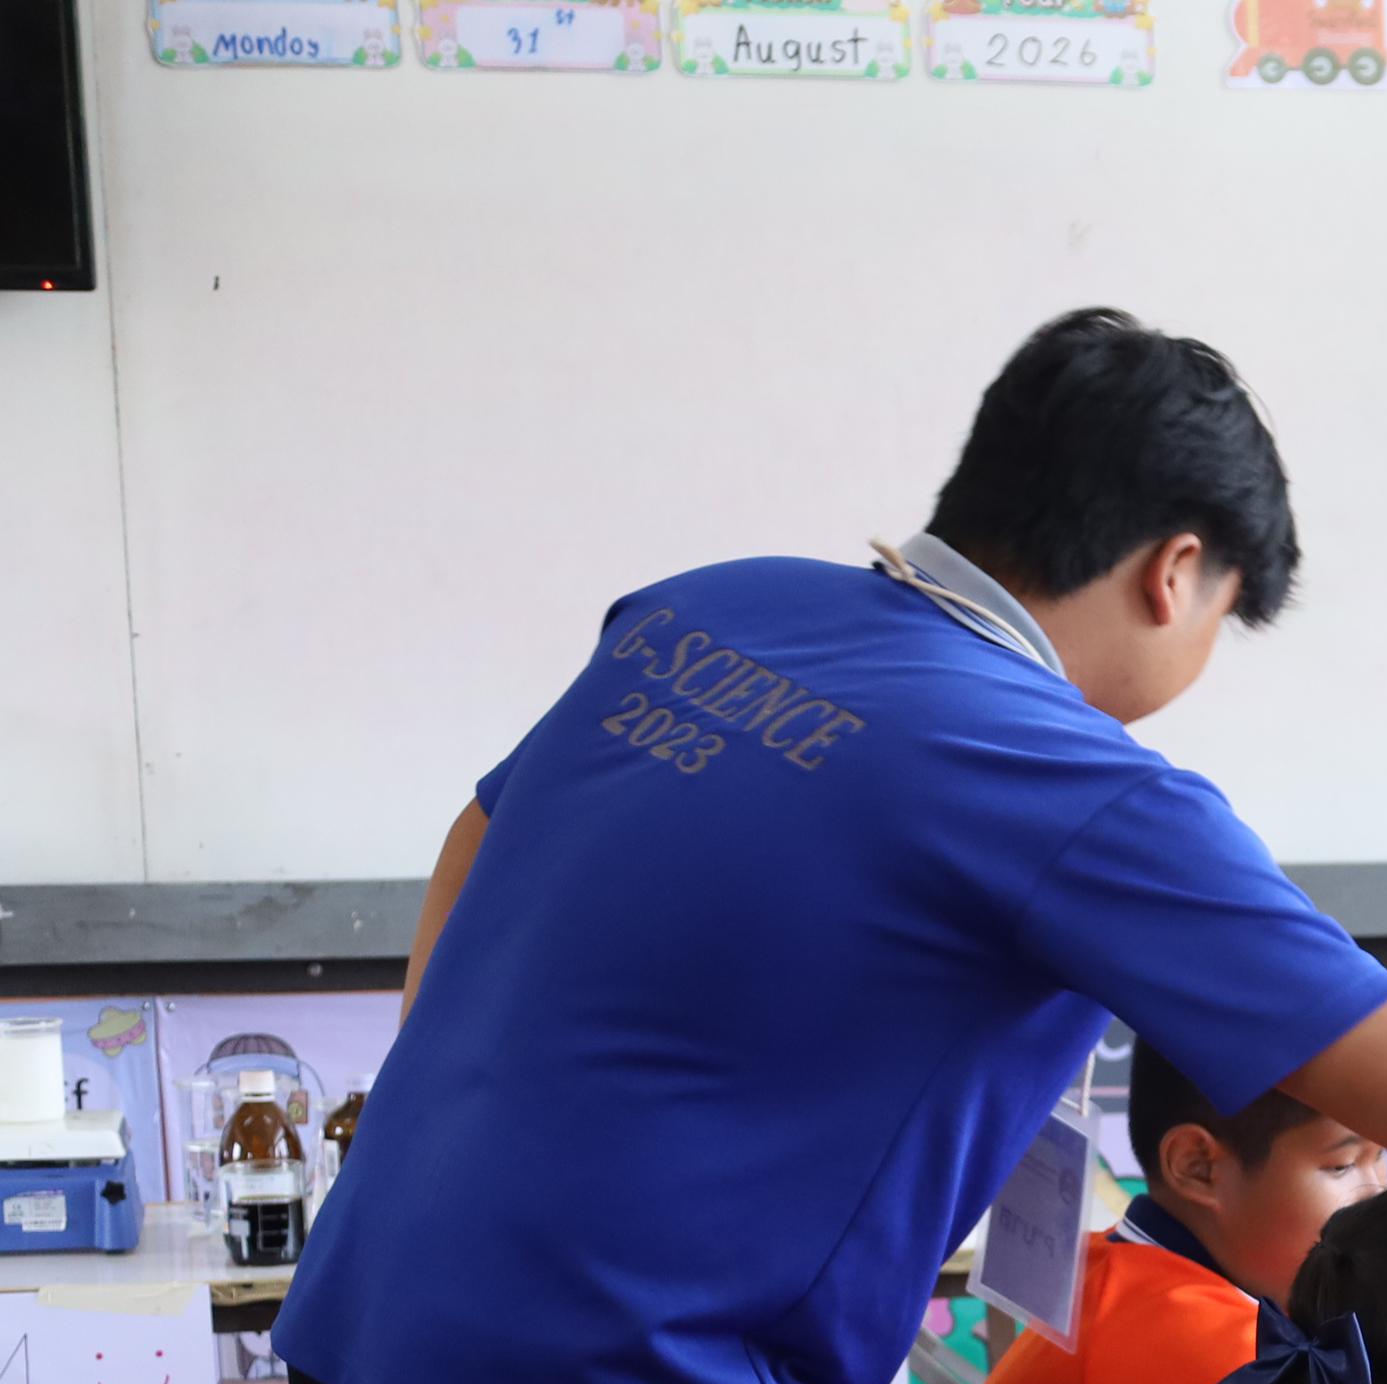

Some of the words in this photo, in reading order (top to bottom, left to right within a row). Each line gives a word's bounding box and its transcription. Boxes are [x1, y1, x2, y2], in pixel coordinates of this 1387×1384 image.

[732, 24, 869, 72] August
[985, 32, 1099, 67] 2026
[612, 607, 866, 771] G-SCIENCE
[602, 692, 727, 775] 2023
